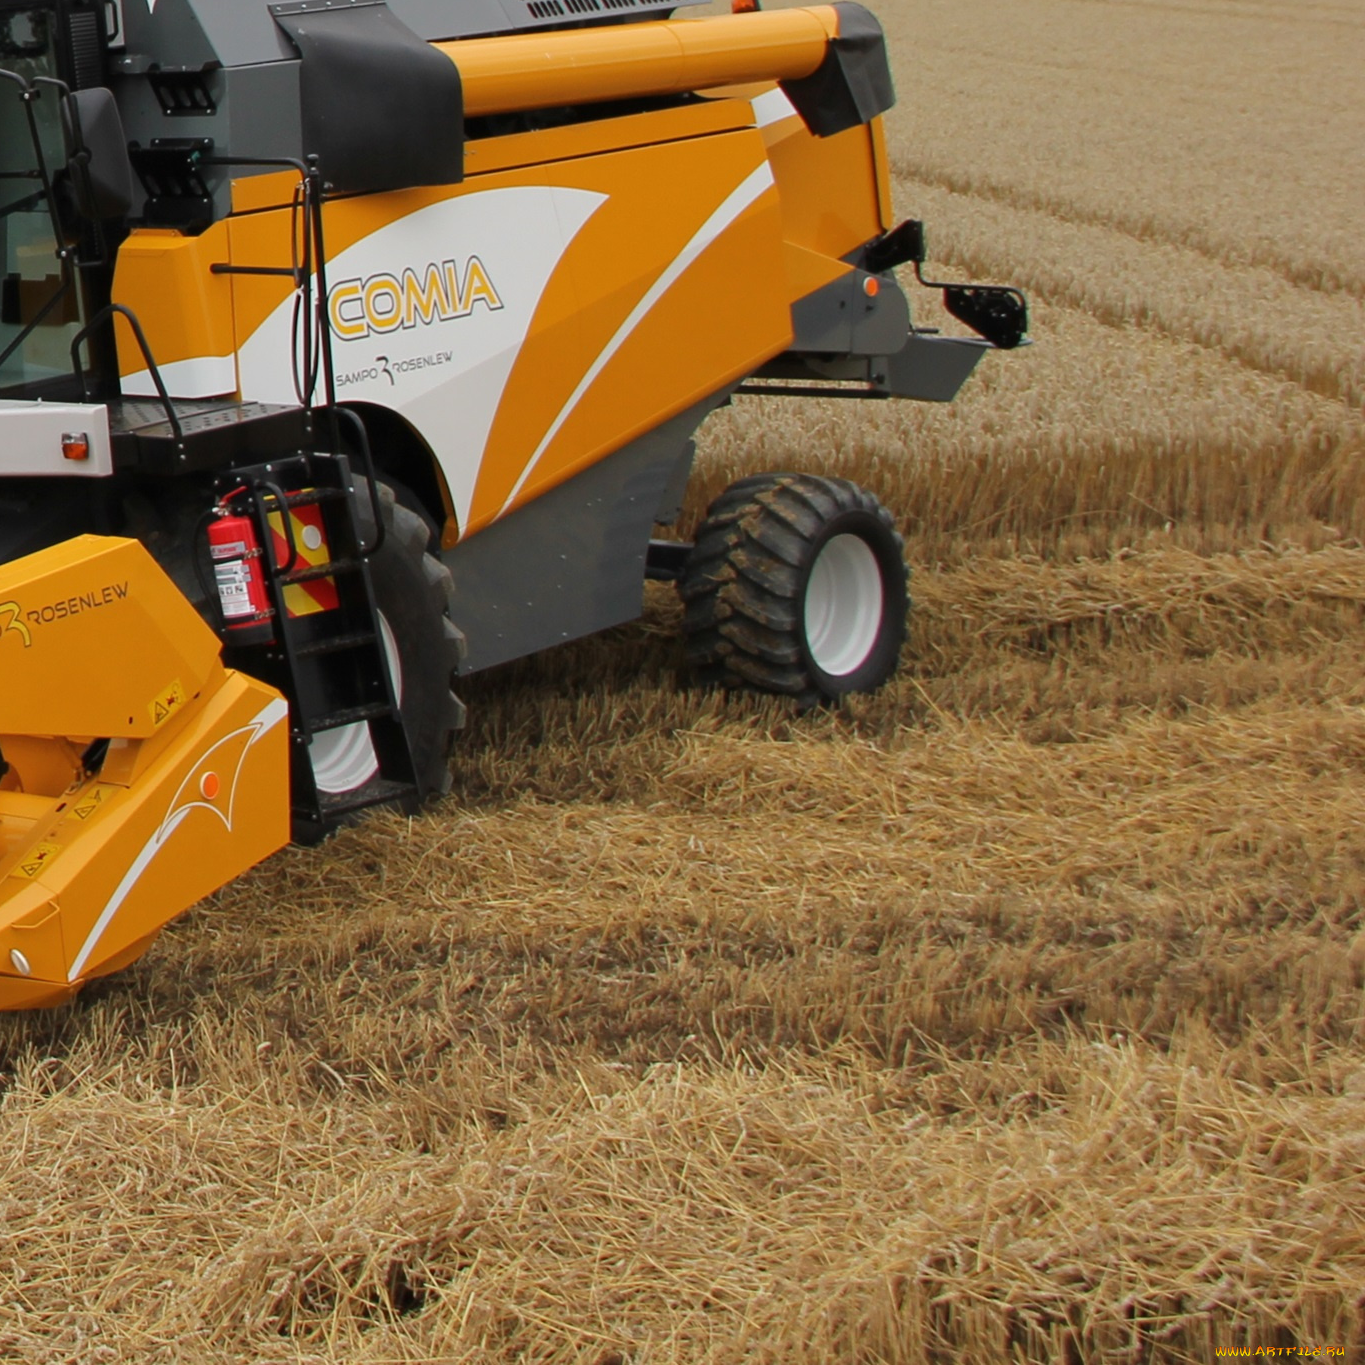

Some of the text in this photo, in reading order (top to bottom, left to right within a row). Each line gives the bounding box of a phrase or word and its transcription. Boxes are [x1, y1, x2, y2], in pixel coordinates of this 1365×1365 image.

[327, 254, 505, 342] COMIA
[335, 350, 454, 387] SAMPO ROSENLEW
[26, 580, 129, 626] ROSENLEW
